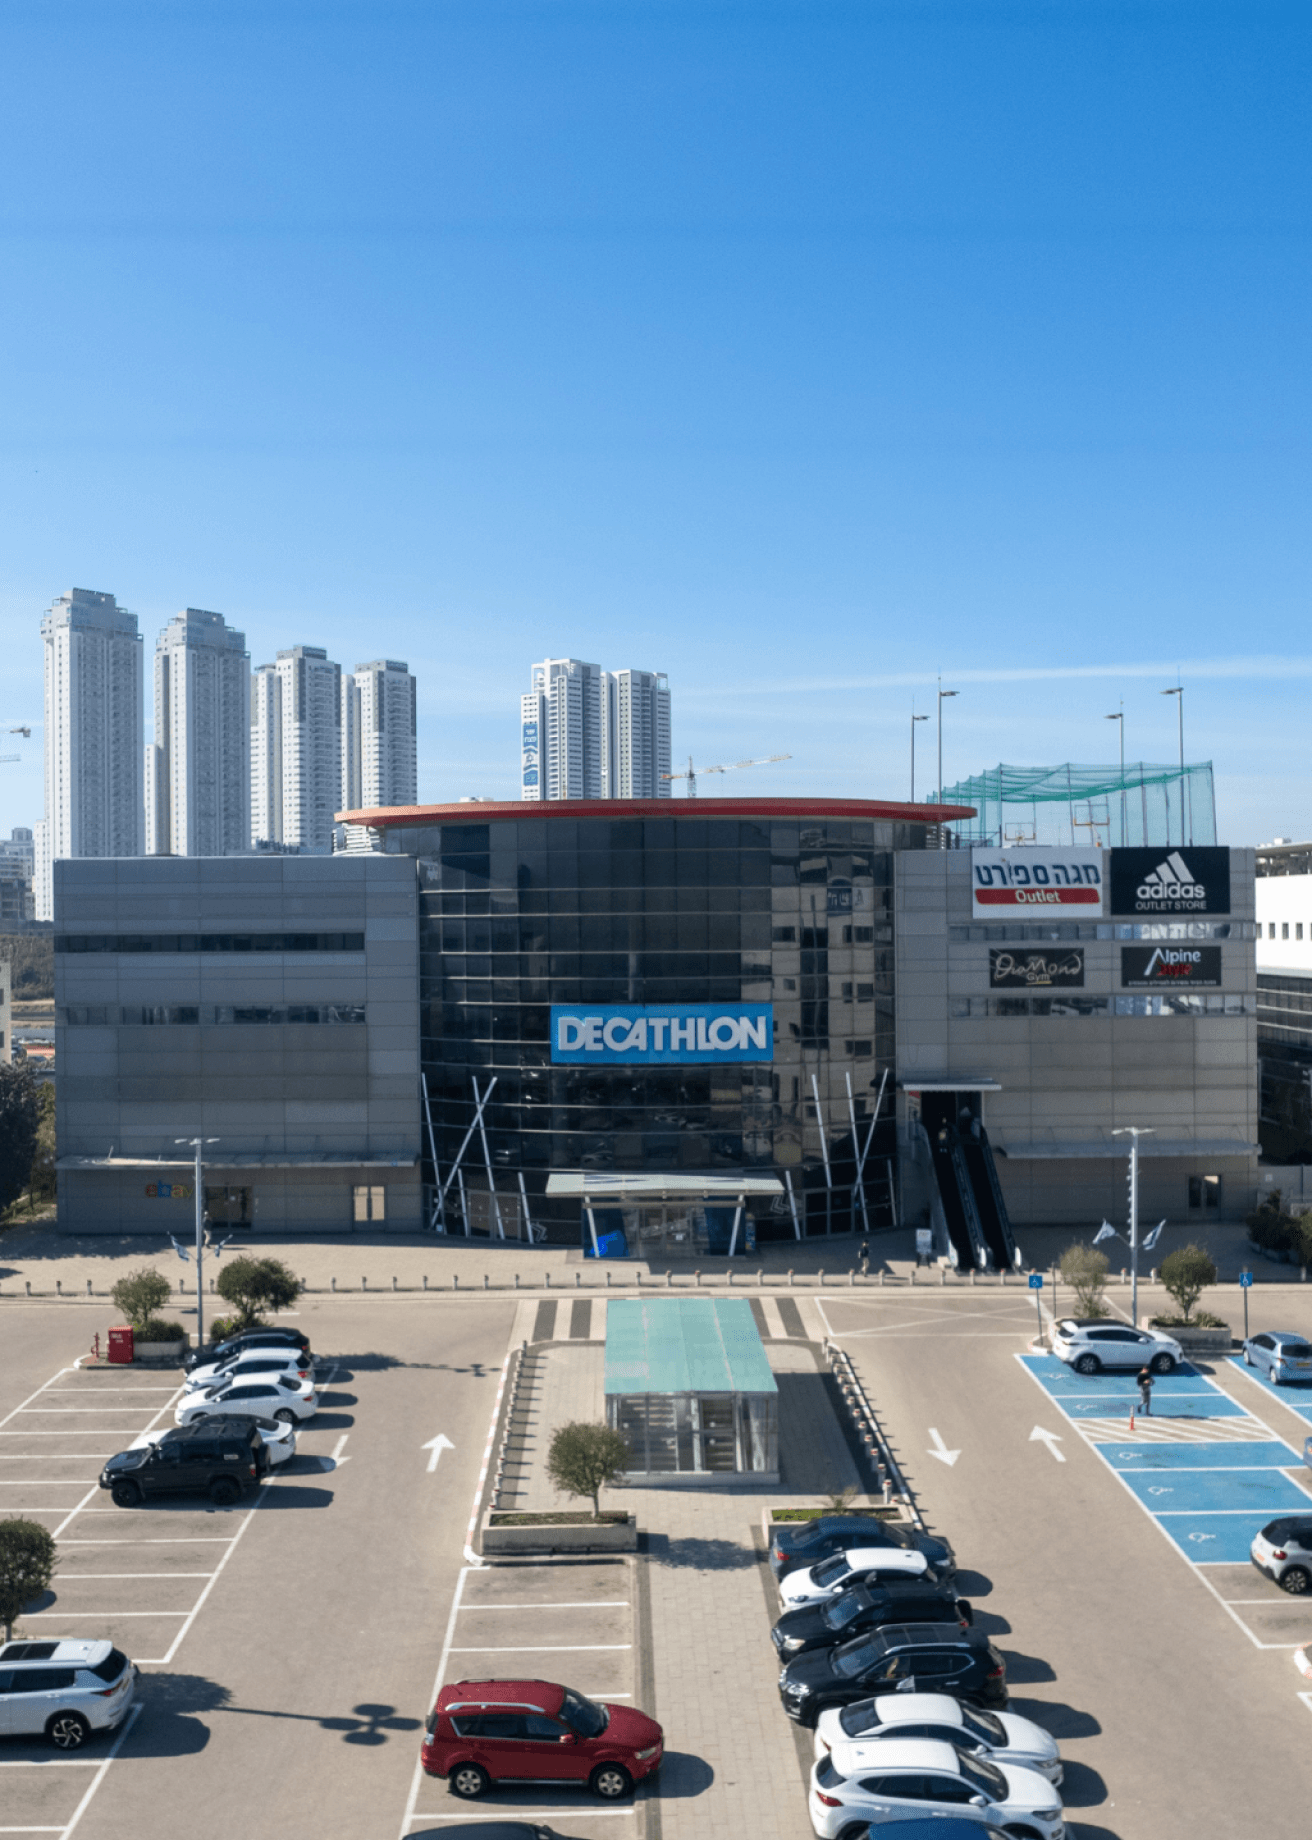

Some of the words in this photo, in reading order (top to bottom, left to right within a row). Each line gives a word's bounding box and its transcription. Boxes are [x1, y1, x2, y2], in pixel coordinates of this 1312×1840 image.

[1015, 889, 1061, 903] Outlet
[1138, 881, 1205, 899] adidas
[1135, 900, 1173, 910] OUTLET
[1174, 900, 1207, 910] STORE
[1144, 947, 1201, 976] Alpine
[1026, 973, 1051, 982] Gym
[558, 1015, 767, 1051] DECATHLON
